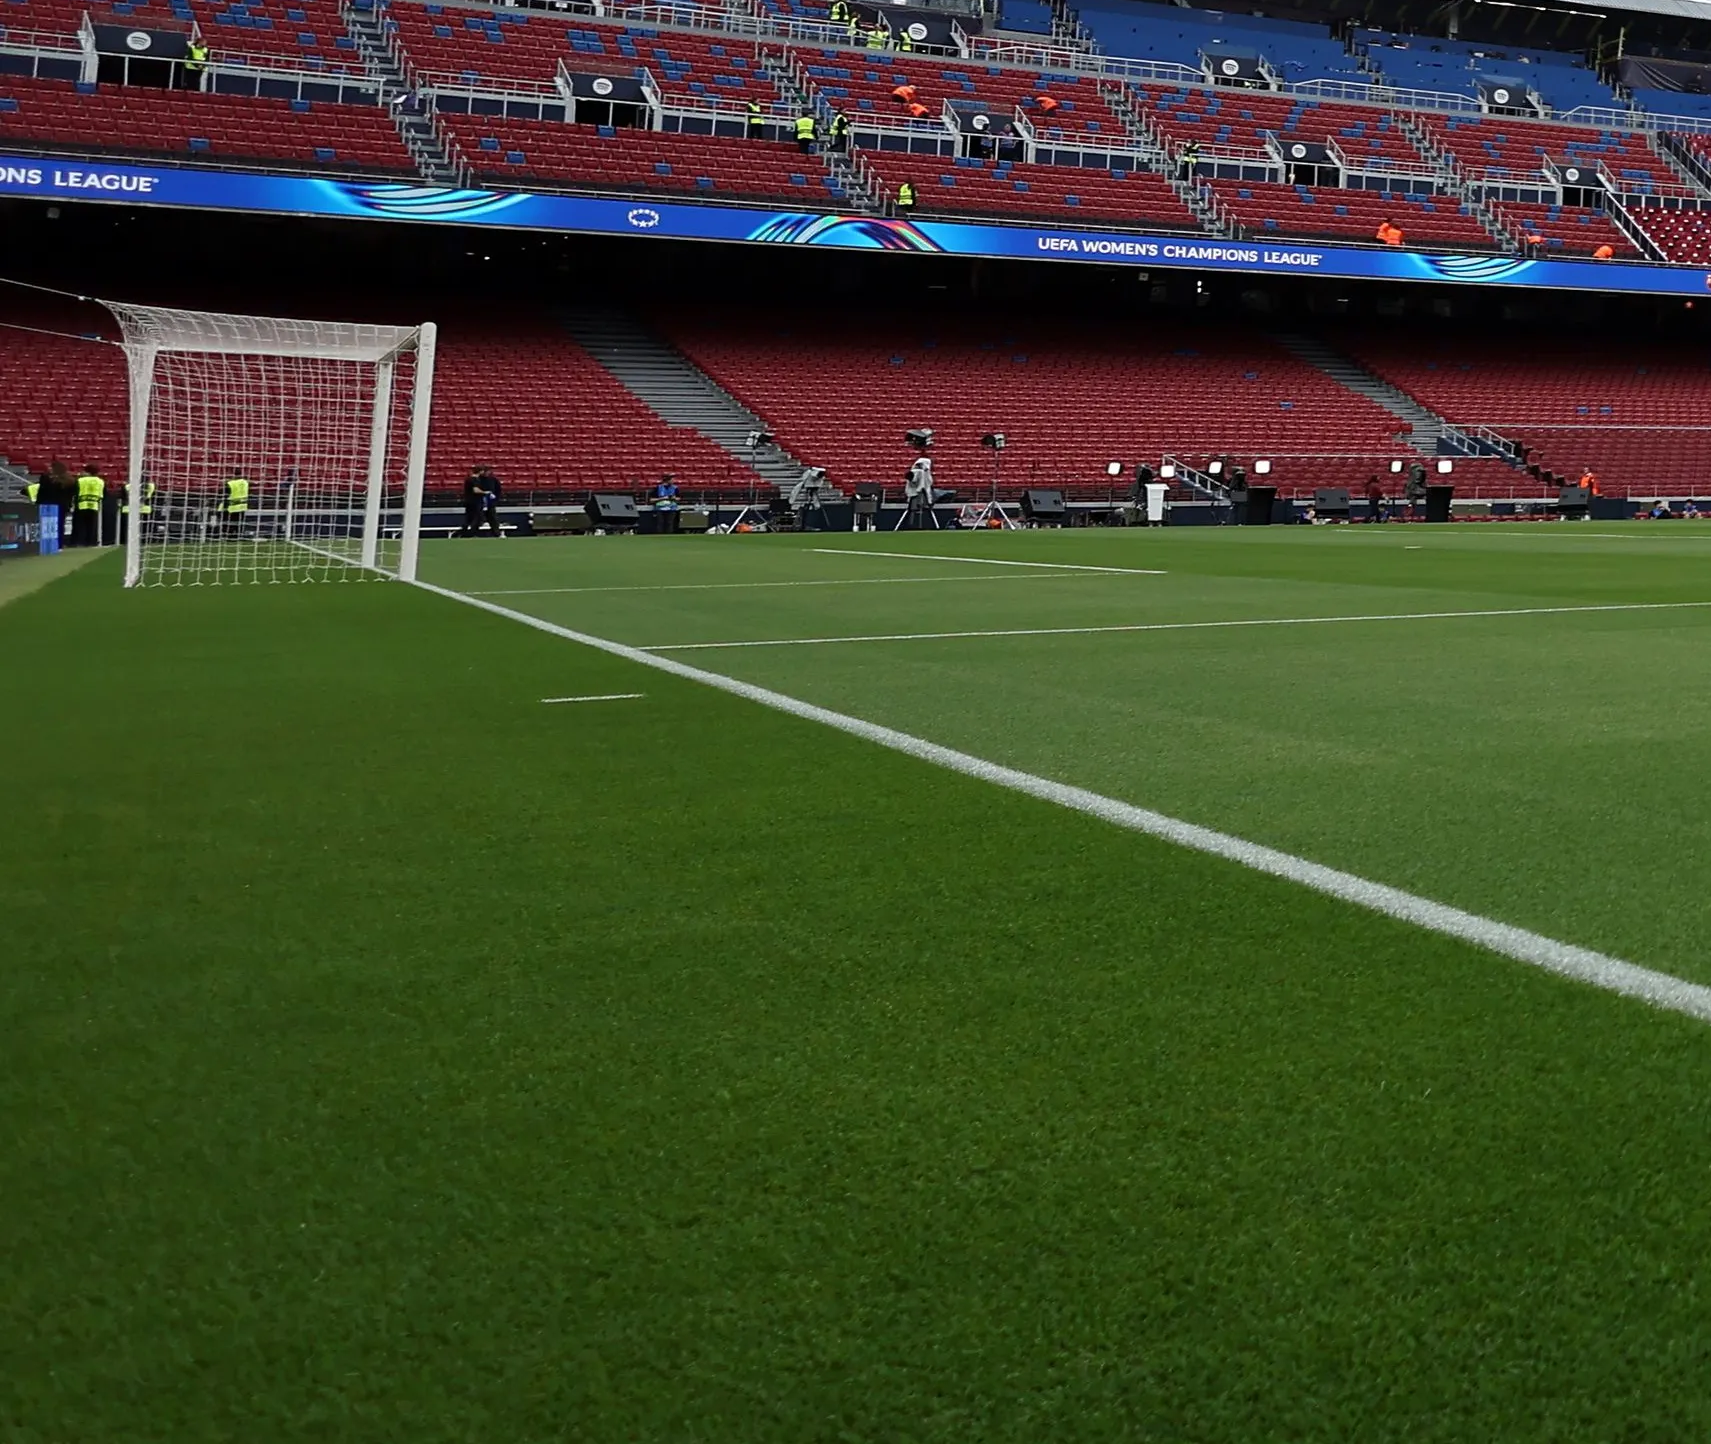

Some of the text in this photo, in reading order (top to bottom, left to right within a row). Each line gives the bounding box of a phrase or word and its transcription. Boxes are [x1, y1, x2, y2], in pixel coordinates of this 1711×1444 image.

[1038, 237, 1079, 252] UEFA
[1081, 239, 1158, 257] WOMEN'S
[1162, 244, 1258, 263] CHAMPIONS
